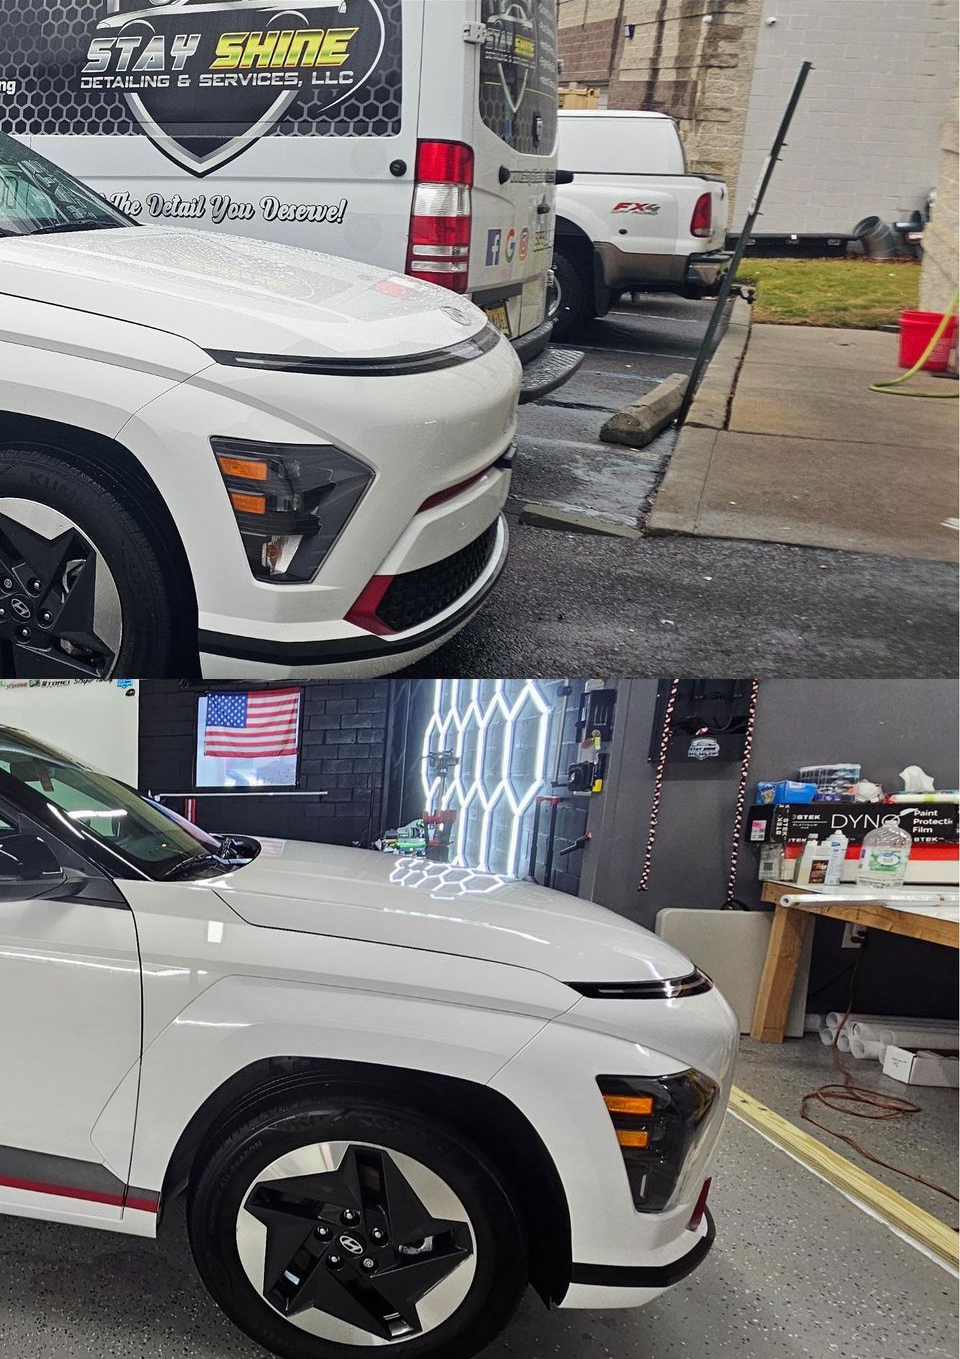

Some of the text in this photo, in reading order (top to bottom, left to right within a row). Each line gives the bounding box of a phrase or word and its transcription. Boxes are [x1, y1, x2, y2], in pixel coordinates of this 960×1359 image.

[80, 27, 360, 73] STAY SHINE
[80, 70, 354, 89] DETAILING & SERVICES, LLC
[110, 190, 348, 224] The Detail You Deserve!
[613, 202, 661, 211] FX4
